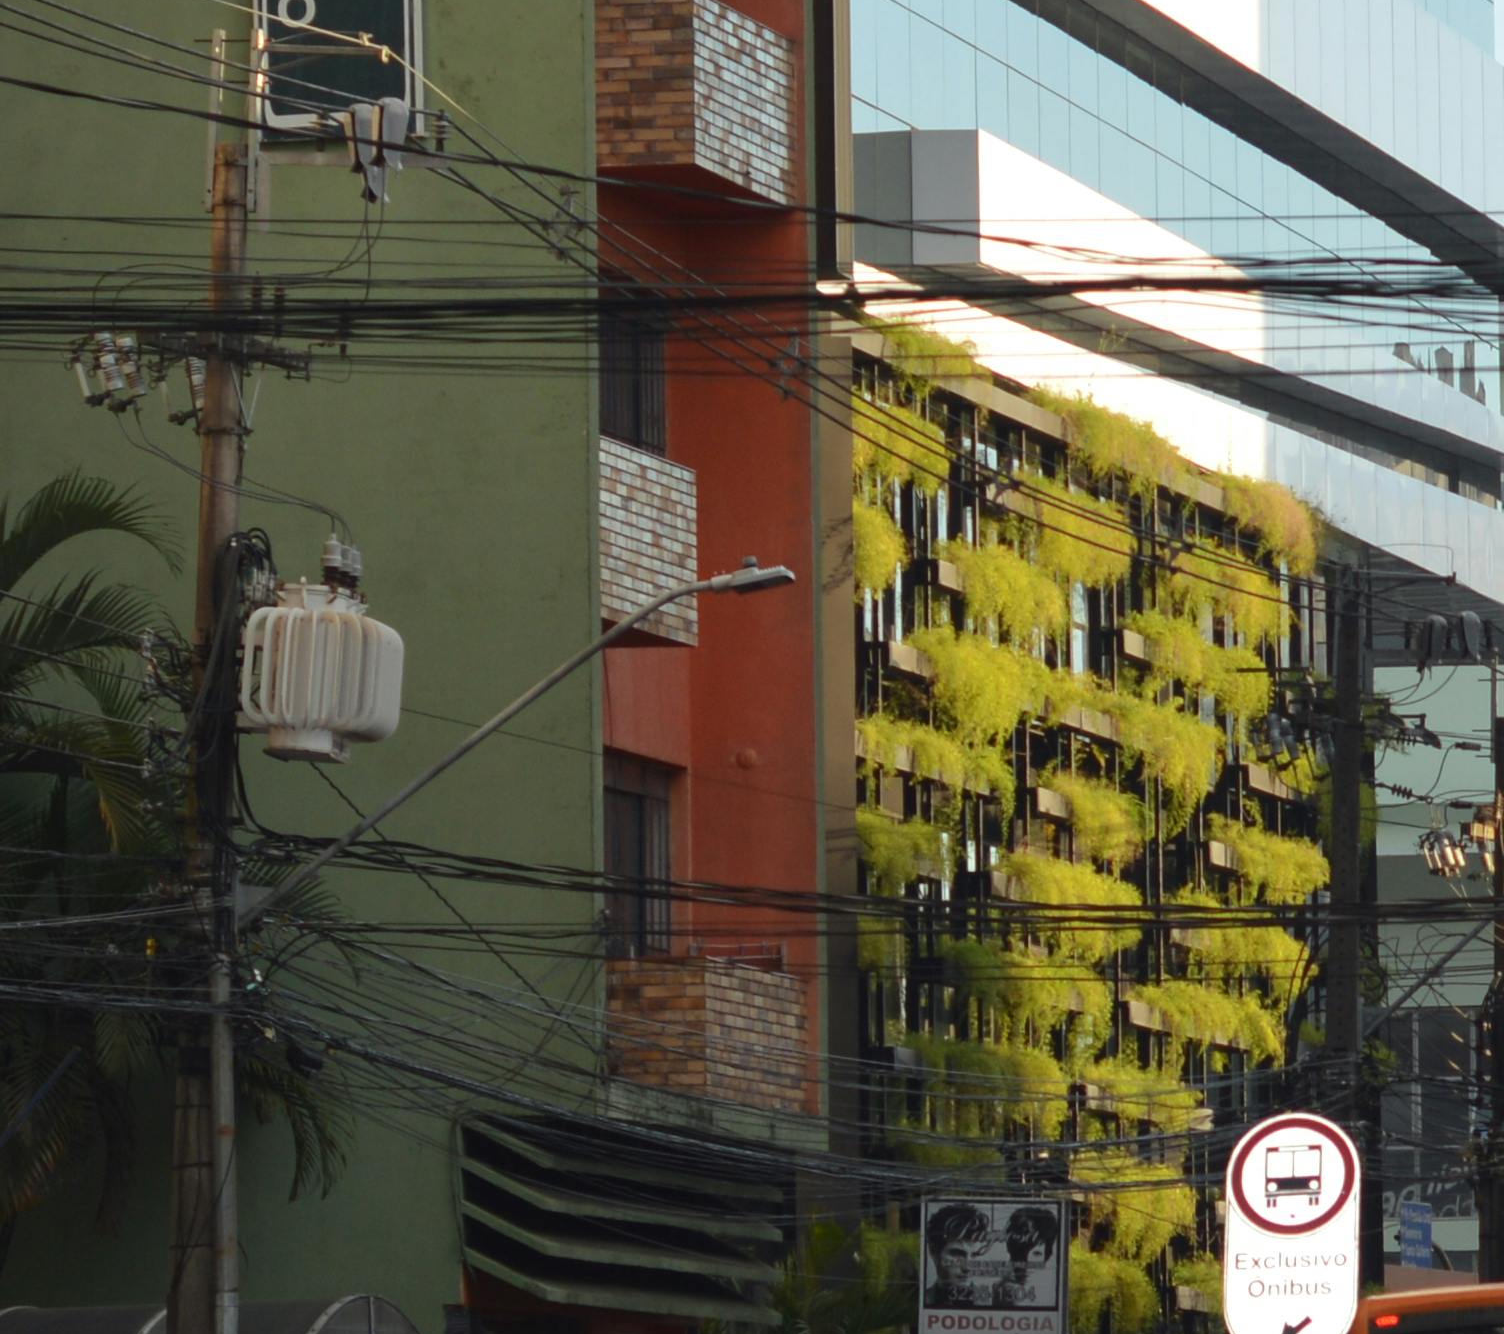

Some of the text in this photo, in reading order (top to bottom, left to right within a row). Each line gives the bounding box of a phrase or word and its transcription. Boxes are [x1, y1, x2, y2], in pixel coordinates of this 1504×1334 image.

[1234, 1251, 1347, 1270] Exclusivo
[1248, 1274, 1332, 1298] Ônibus
[926, 1315, 1054, 1331] PODOLOGIA
